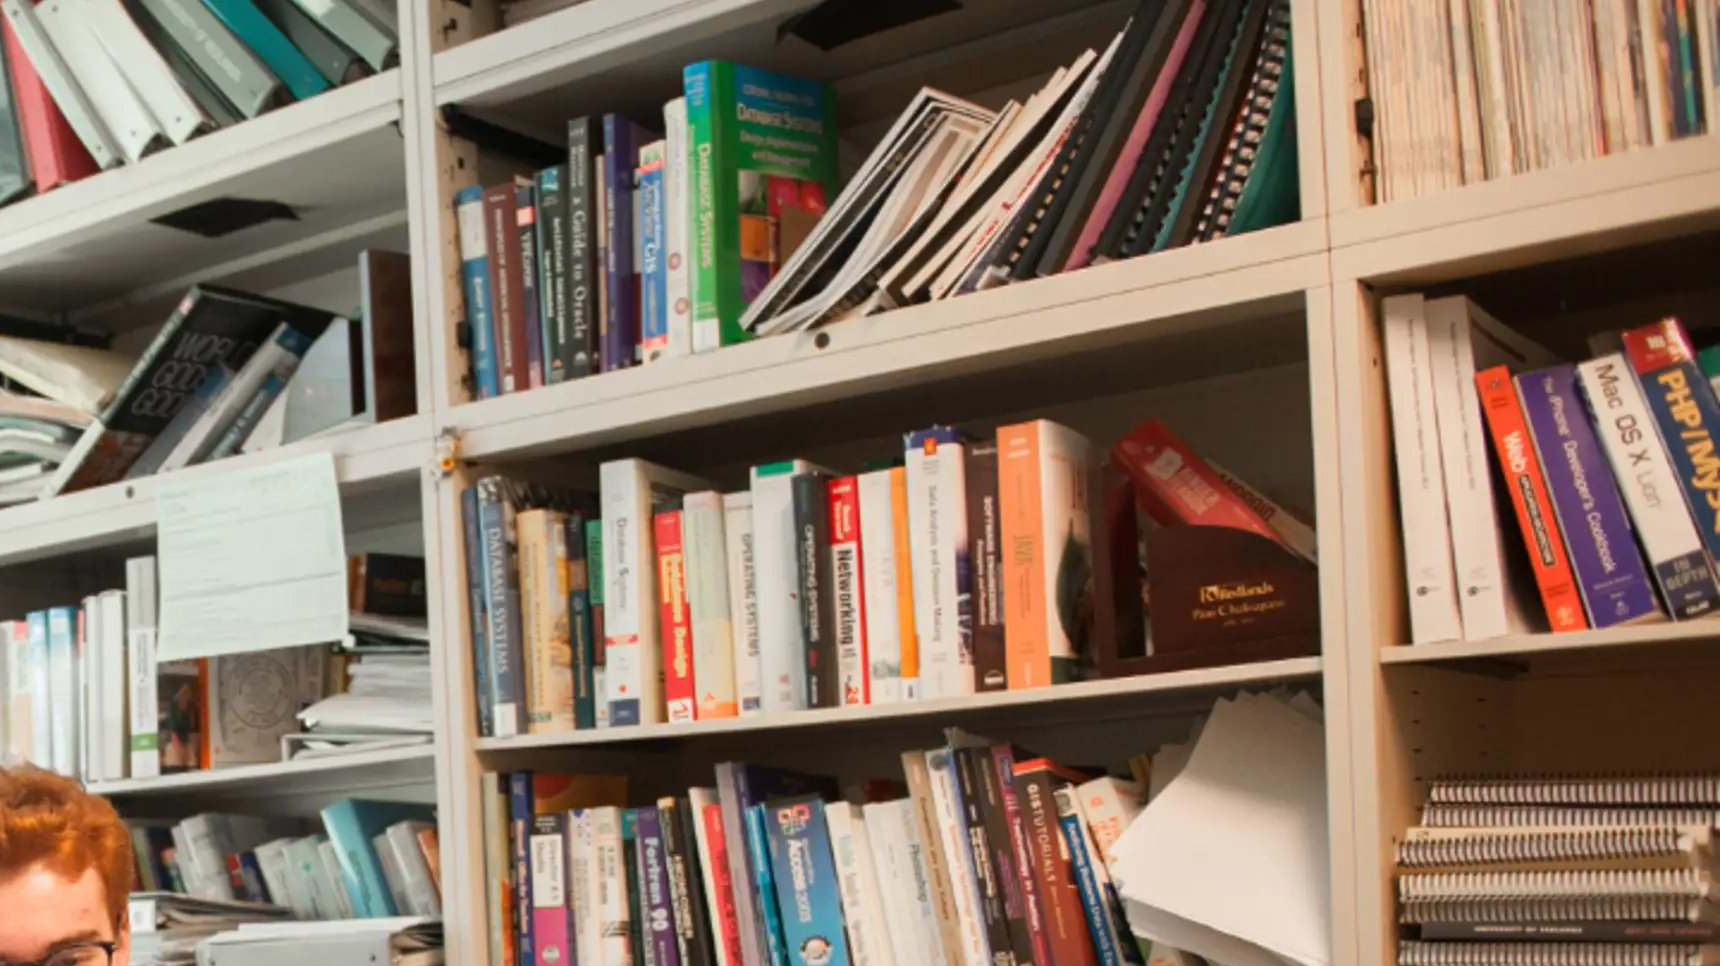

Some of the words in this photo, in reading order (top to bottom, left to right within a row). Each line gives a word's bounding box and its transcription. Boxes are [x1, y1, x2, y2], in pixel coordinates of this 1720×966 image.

[572, 210, 584, 257] Guide
[573, 285, 586, 338] Oracle
[1595, 363, 1625, 409] Mac
[1502, 430, 1528, 473] Web
[1615, 414, 1642, 447] OS
[1547, 393, 1571, 436] iPhone
[1562, 438, 1597, 511] Developer's
[1586, 510, 1618, 573] Cookbook
[1628, 449, 1653, 469] X
[487, 527, 506, 601] DATABASE
[740, 533, 755, 598] OPERATING
[835, 549, 856, 645] Networking
[492, 607, 509, 673] SYSTEMS
[744, 602, 759, 656] SYSTEMS
[645, 836, 664, 904] Fortran
[786, 838, 807, 891] Access
[909, 843, 929, 902] Photoshop
[650, 907, 668, 931] 90
